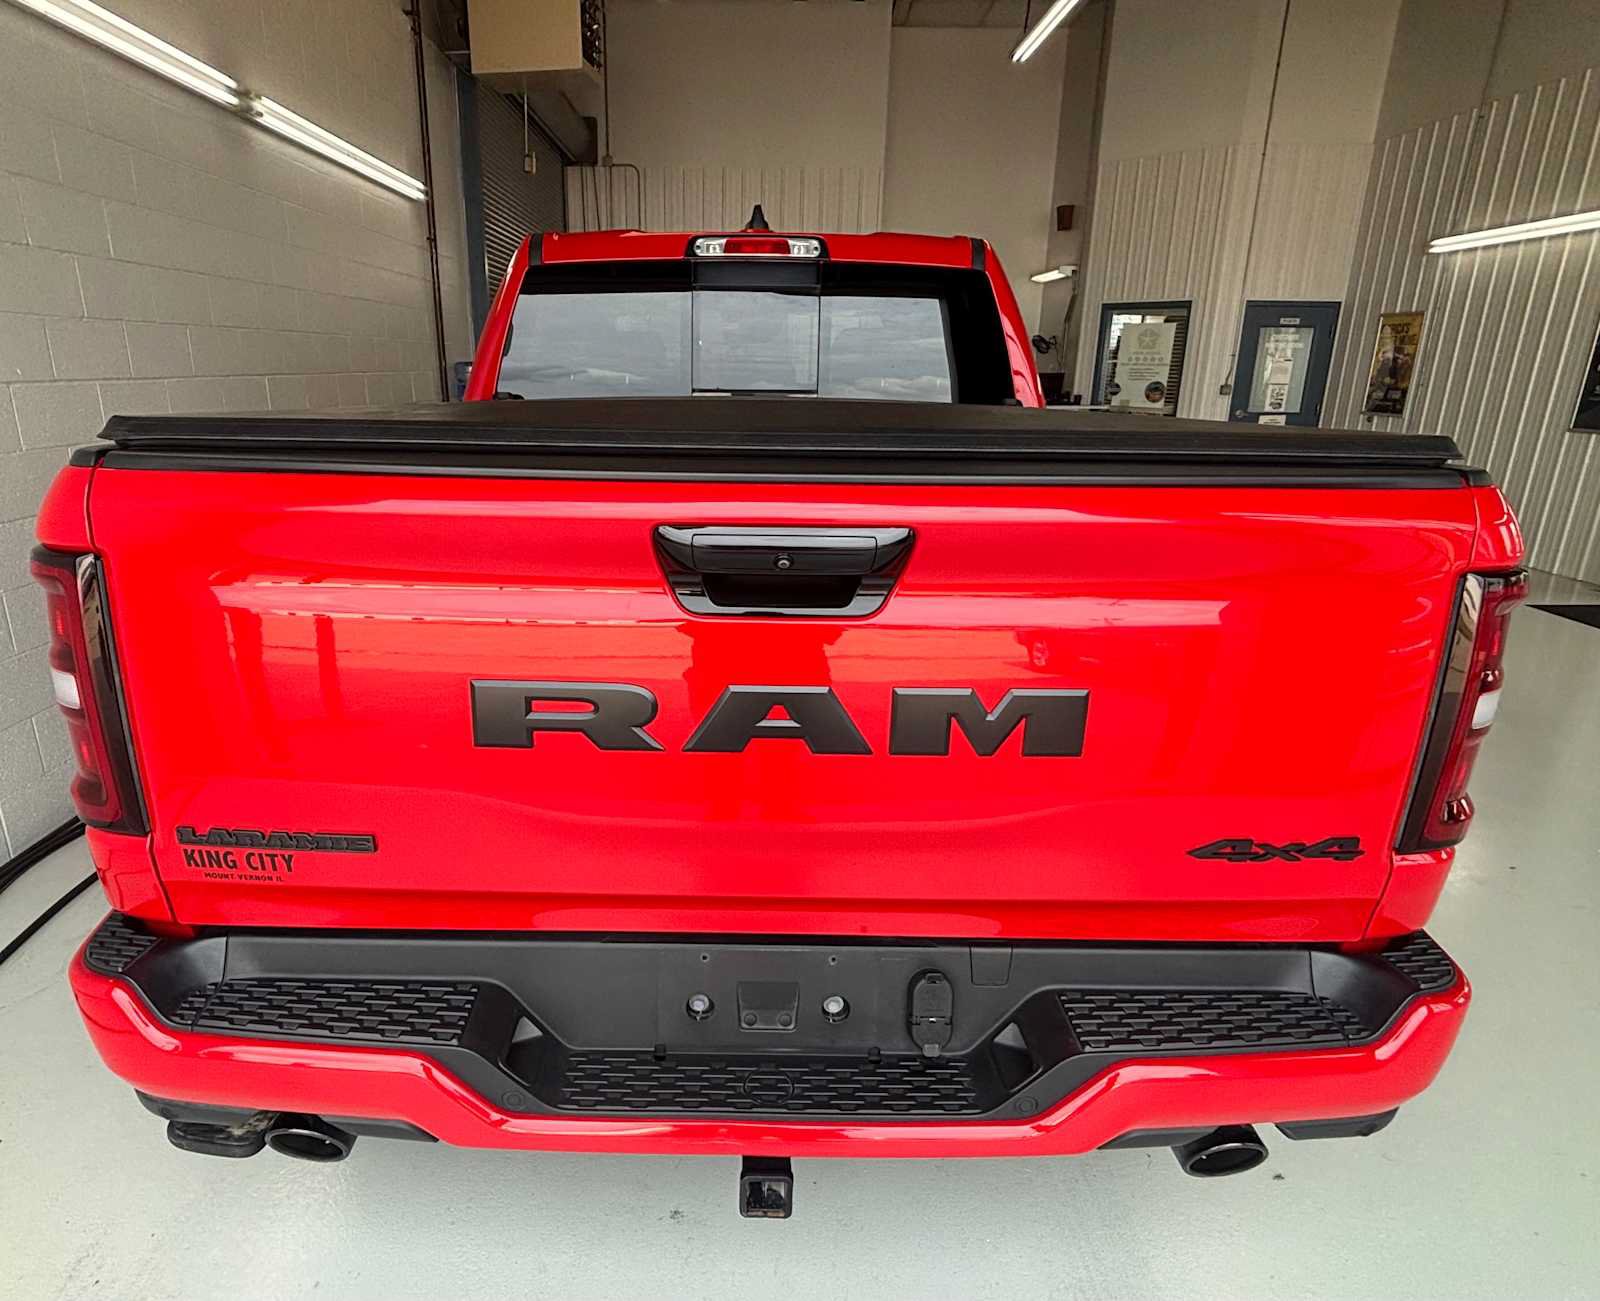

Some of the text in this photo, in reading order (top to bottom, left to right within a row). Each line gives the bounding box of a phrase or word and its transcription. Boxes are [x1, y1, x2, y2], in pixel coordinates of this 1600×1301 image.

[470, 679, 1090, 757] RAM
[175, 825, 378, 853] LARAMIE
[183, 848, 294, 873] KING CITY
[204, 871, 235, 880] MOUNT
[238, 873, 273, 882] VERNON
